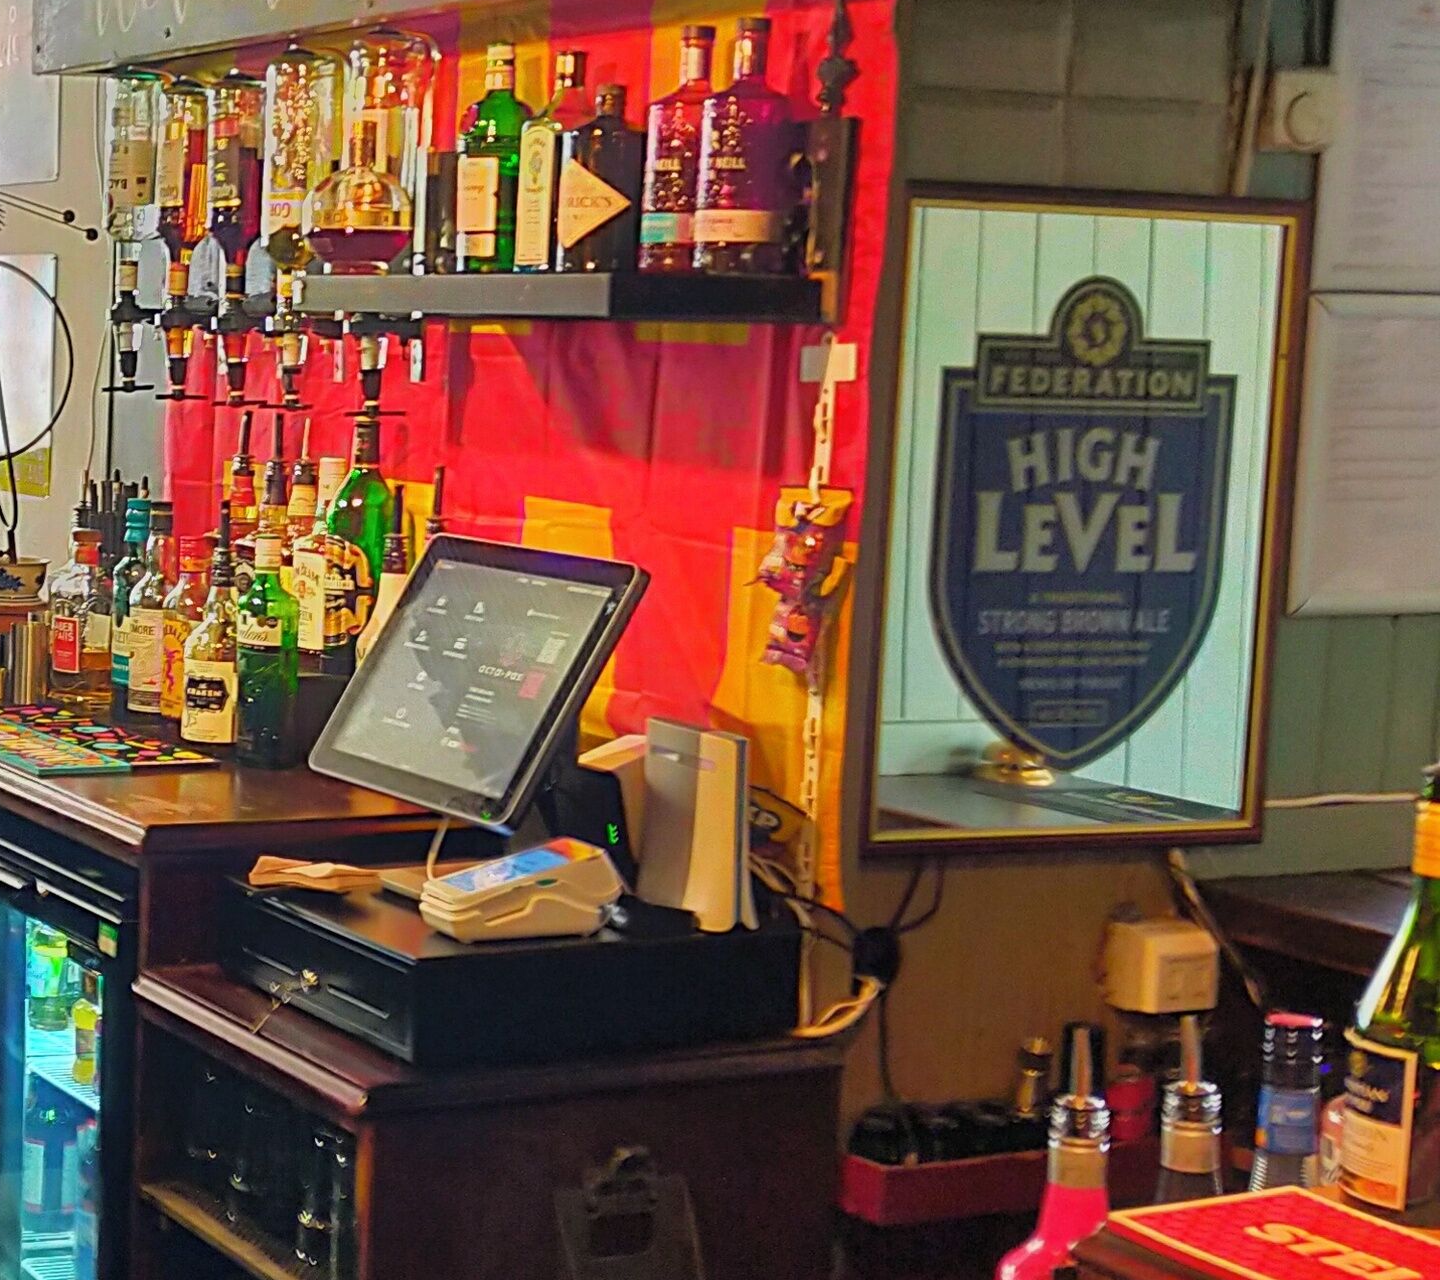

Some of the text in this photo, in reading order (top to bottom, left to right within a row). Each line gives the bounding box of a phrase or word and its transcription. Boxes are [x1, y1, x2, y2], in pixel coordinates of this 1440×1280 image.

[990, 366, 1194, 397] FEDERATION
[1006, 426, 1162, 494] HIGH
[972, 490, 1197, 575] LEVEL
